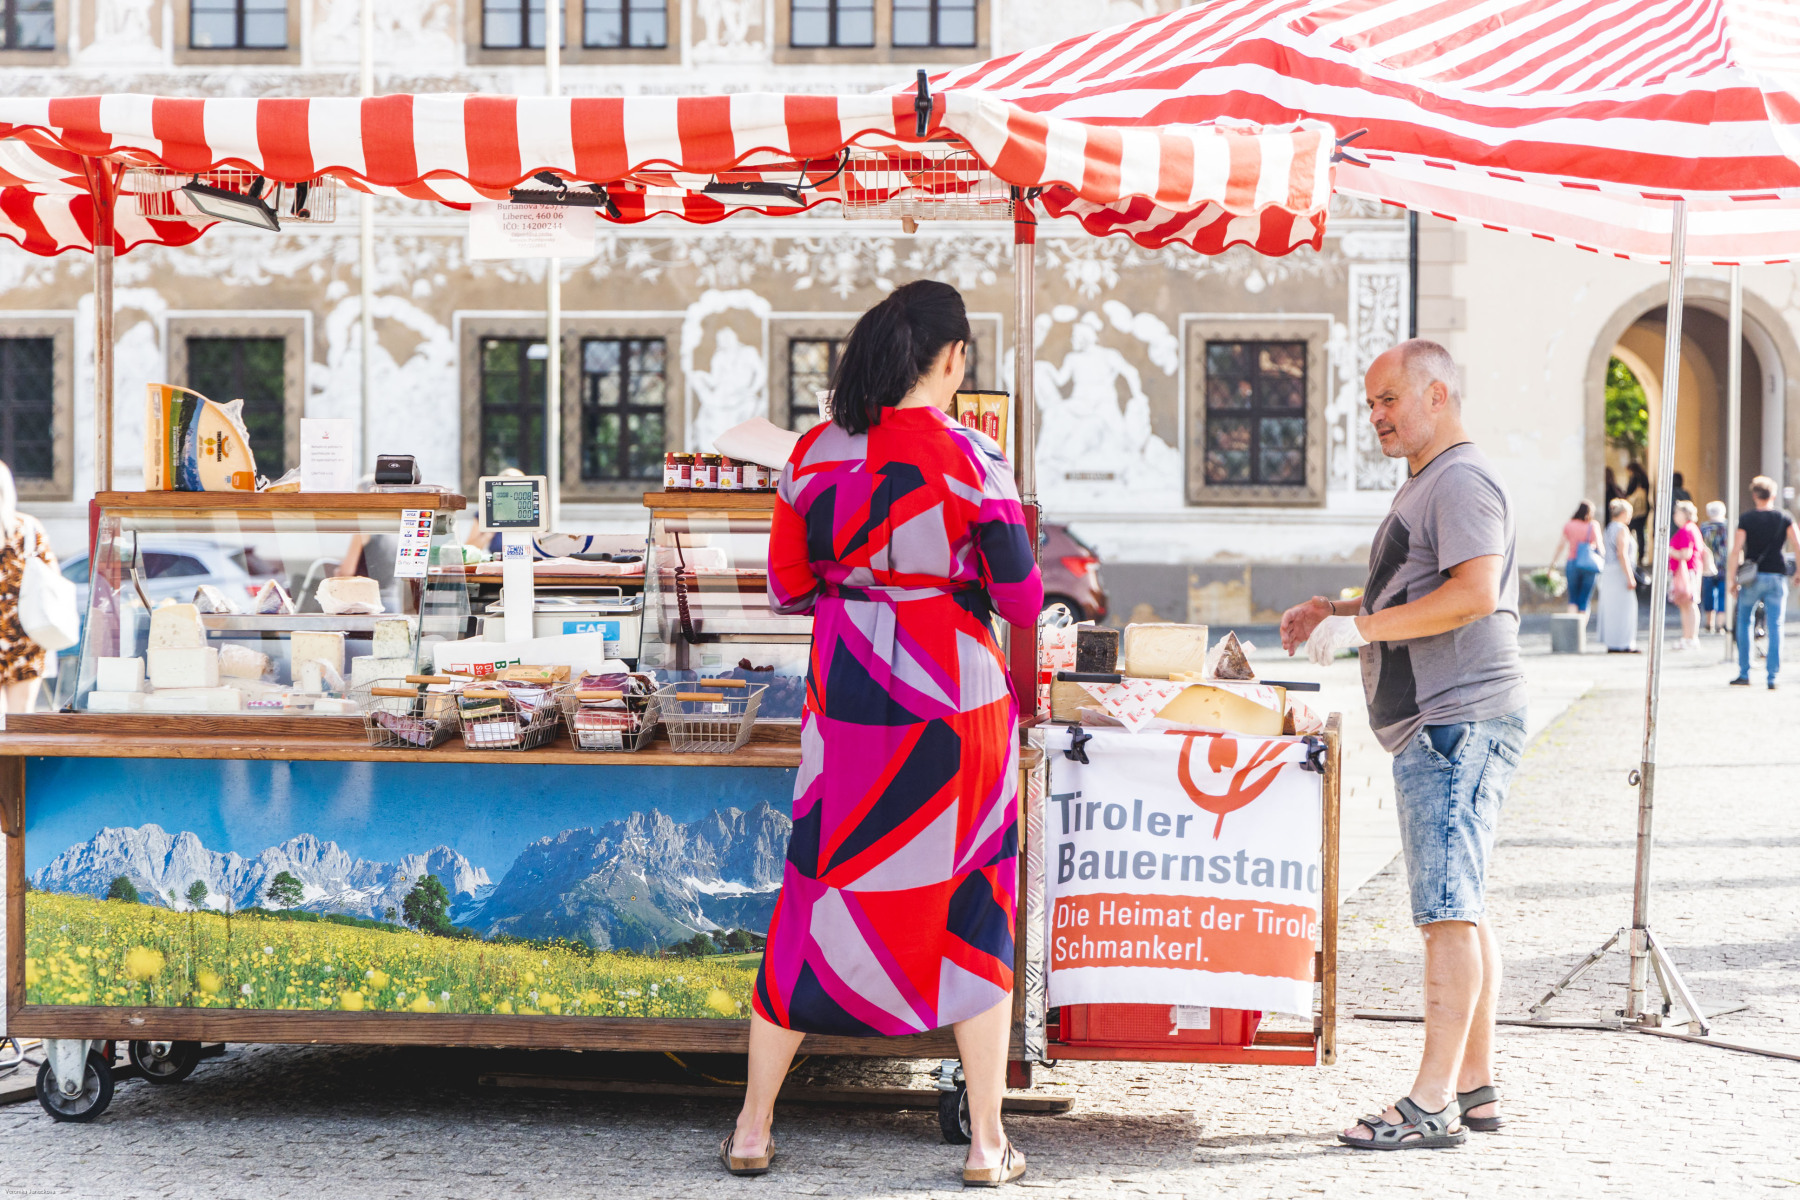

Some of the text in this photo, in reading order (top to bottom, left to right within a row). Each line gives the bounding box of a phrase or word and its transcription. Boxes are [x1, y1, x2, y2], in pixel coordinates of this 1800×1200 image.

[502, 212, 564, 220] Liberec, 460 06
[503, 222, 562, 230] IČO: 14200244
[576, 623, 607, 633] CAS
[1052, 791, 1193, 838] Tiroler
[1057, 904, 1090, 929] Die
[1100, 901, 1192, 928] Heimat
[1200, 905, 1245, 931] der
[1055, 935, 1209, 962] Schmankerl.
